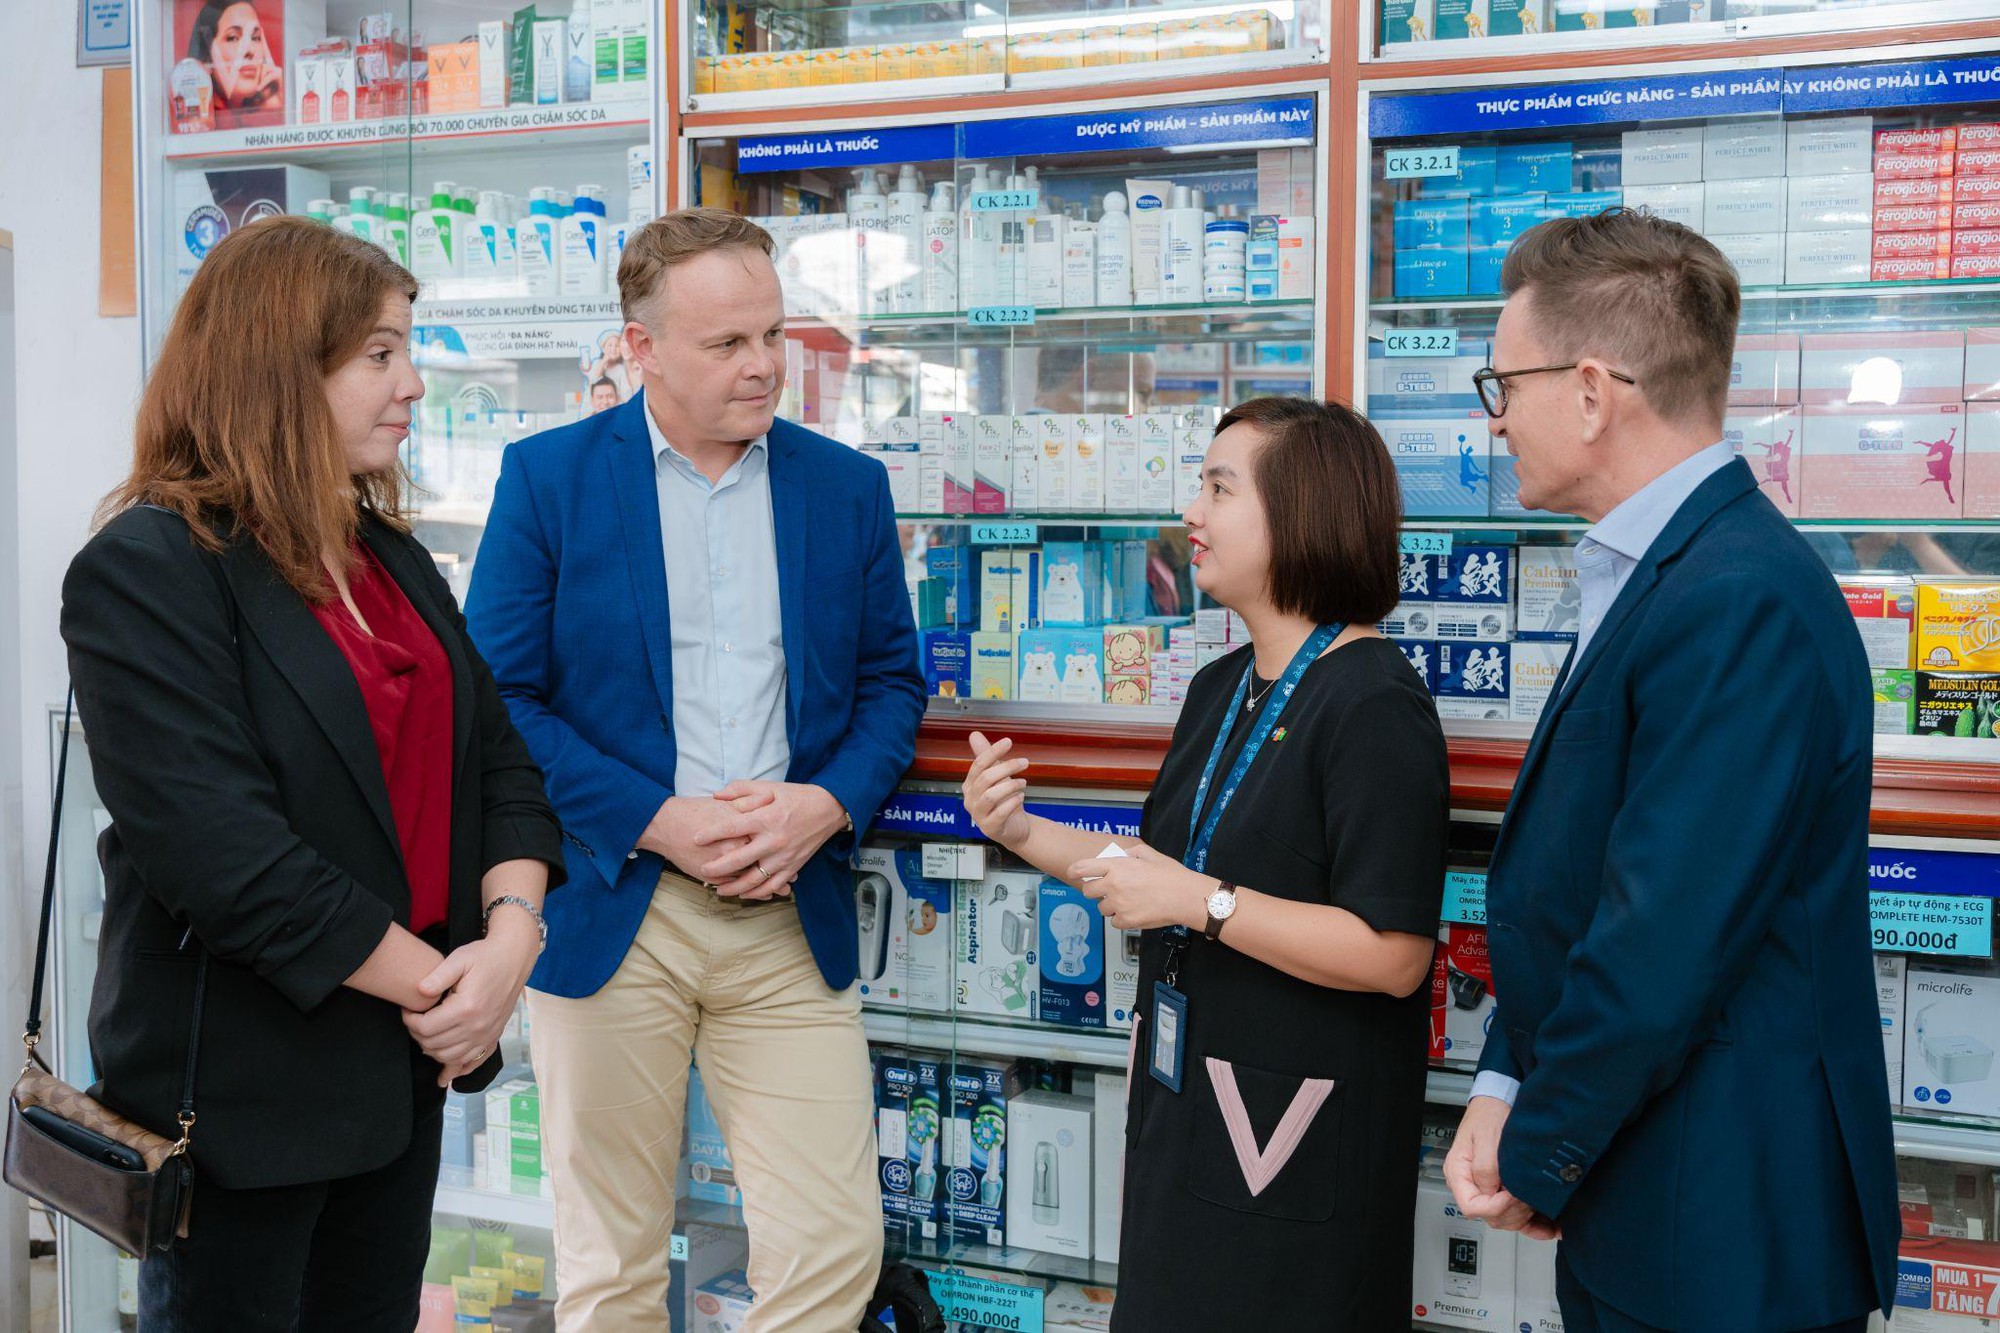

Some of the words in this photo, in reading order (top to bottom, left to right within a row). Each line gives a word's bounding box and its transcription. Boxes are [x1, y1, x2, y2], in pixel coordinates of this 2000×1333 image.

[1477, 101, 1519, 115] THỰC
[1524, 93, 1572, 111] PHẨM
[1576, 91, 1622, 108] CHỨC
[1626, 87, 1674, 104] NĂNG
[1690, 80, 1725, 98] SẢN
[1730, 77, 1780, 96] PHẨM
[1783, 78, 1804, 94] ÀY
[1808, 76, 1871, 93] KHÔNG
[1876, 70, 1920, 89] PHẢI
[1925, 69, 1948, 86] LÀ
[430, 119, 465, 133] 70.000
[511, 113, 530, 127] GIA
[1077, 122, 1116, 137] DƯỢC
[1120, 119, 1142, 134] MỸ
[1145, 116, 1186, 132] PHẨM
[1200, 111, 1229, 128] SẢN
[1233, 107, 1275, 125] PHẨM
[1280, 107, 1310, 122] NÀY
[1879, 130, 1941, 146] Feroglobin
[739, 144, 782, 159] KHÔNG
[784, 140, 814, 156] PHẢI
[817, 139, 833, 153] LÀ
[835, 135, 880, 152] THUỐC
[1389, 158, 1409, 172] CK
[1413, 155, 1453, 170] 3.2.1
[1877, 156, 1938, 172] Feroglobin
[1877, 181, 1938, 197] Feroglobin
[977, 196, 999, 208] CK
[1003, 194, 1030, 207] 2.2.1
[1137, 198, 1162, 206] REDWIN
[1490, 205, 1524, 216] Omega
[1875, 207, 1937, 223] Feroglobin
[198, 219, 215, 248] 3
[1874, 259, 1934, 275] Feroglobin
[466, 304, 486, 318] SÓC
[488, 306, 502, 317] DA
[504, 303, 546, 317] KHUYÊN
[548, 302, 578, 316] DÙNG
[975, 311, 997, 323] CK
[1000, 309, 1028, 322] 2.2.2
[1388, 336, 1408, 350] CK
[1412, 336, 1451, 350] 3.2.2
[1396, 382, 1435, 392] B-TEEN
[1398, 443, 1436, 453] B-TEEN
[977, 528, 998, 540] CK
[1002, 528, 1031, 540] 2.2.3
[1411, 538, 1445, 551] 3.2.3
[1524, 579, 1570, 589] Premium
[1929, 679, 1979, 691] MEDSULIN
[1920, 700, 1973, 710] ニガウリエキス
[884, 806, 911, 821] SẢN
[915, 808, 955, 824] PHẨM
[1869, 862, 1917, 880] HUỐC
[1893, 898, 1906, 909] áp
[1924, 899, 1951, 911] động
[1964, 902, 1984, 911] ECG
[1869, 911, 1919, 922] OMPLETE
[1922, 914, 1984, 926] HEM-7530T
[968, 898, 979, 964] Aspirator
[1874, 929, 1958, 950] 90.000đ
[1917, 981, 1973, 996] microlife
[921, 1068, 935, 1078] 2X
[986, 1075, 1000, 1085] 2X
[965, 1092, 978, 1100] 500
[910, 1205, 931, 1214] CLEAN
[959, 1211, 975, 1220] DEEP
[976, 1213, 997, 1222] CLEAN
[1455, 1244, 1476, 1262] 103
[1937, 1268, 1969, 1287] MUA
[1974, 1273, 1981, 1287] 1
[941, 1289, 975, 1302] OMRON
[977, 1294, 1017, 1308] HBF-222T
[1434, 1300, 1476, 1316] Premier
